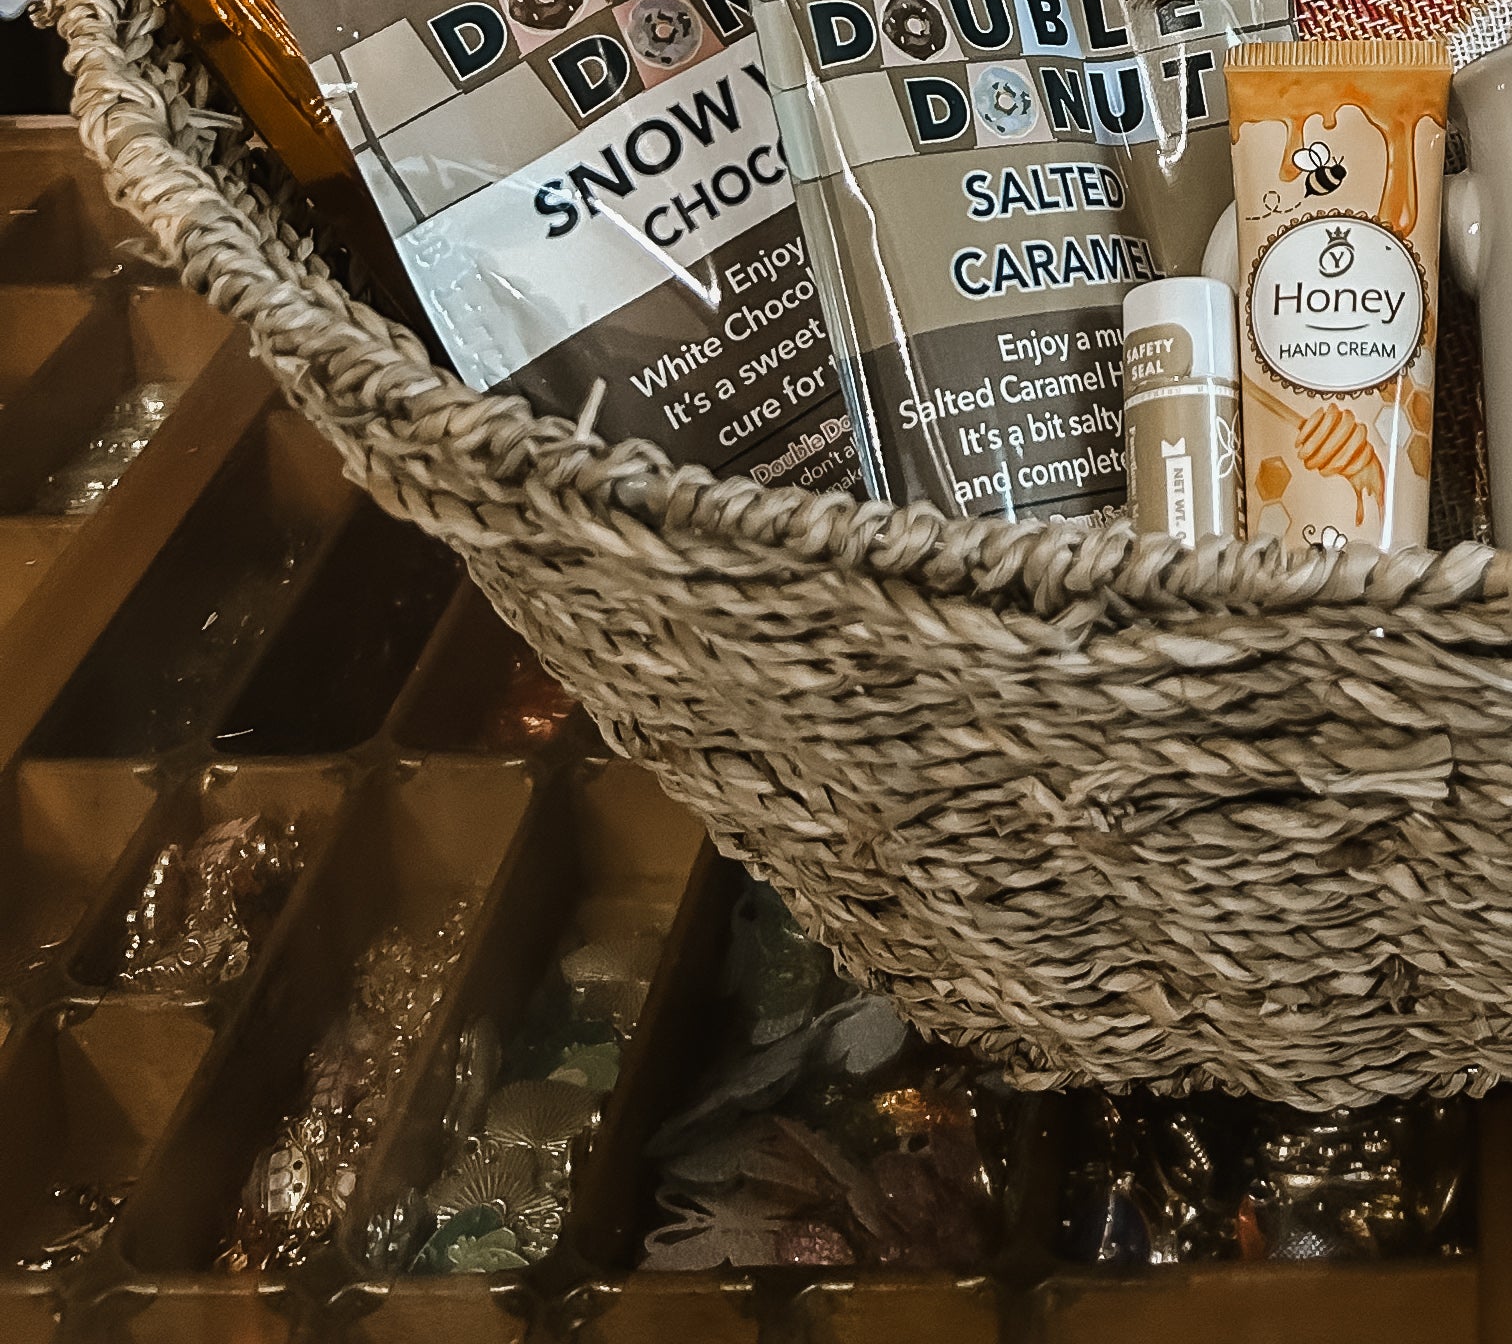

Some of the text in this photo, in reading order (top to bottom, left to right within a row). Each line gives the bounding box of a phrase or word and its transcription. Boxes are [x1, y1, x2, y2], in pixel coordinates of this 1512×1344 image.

[904, 50, 1216, 145] DONUT
[534, 75, 741, 238] SNOW
[644, 138, 788, 246] CHOC
[962, 162, 1126, 220] SALTED
[725, 236, 804, 295] Enjoy
[951, 234, 1167, 299] CARAMEL
[629, 267, 818, 398] White Chocol
[1273, 282, 1407, 325] Honey
[663, 392, 712, 430] It's
[715, 378, 736, 400] a
[739, 318, 827, 385] sweet
[998, 327, 1124, 366] Enjoy a mu
[1126, 338, 1174, 364] SAFETY
[1131, 360, 1165, 381] SEAL
[1279, 339, 1397, 362] HAND CREAM
[718, 365, 826, 447] cure for
[899, 368, 1106, 430] Salted Caramel
[958, 403, 1123, 456] It's a bit salty
[750, 432, 825, 486] Double
[954, 470, 1011, 505] and
[1173, 467, 1184, 496] NET
